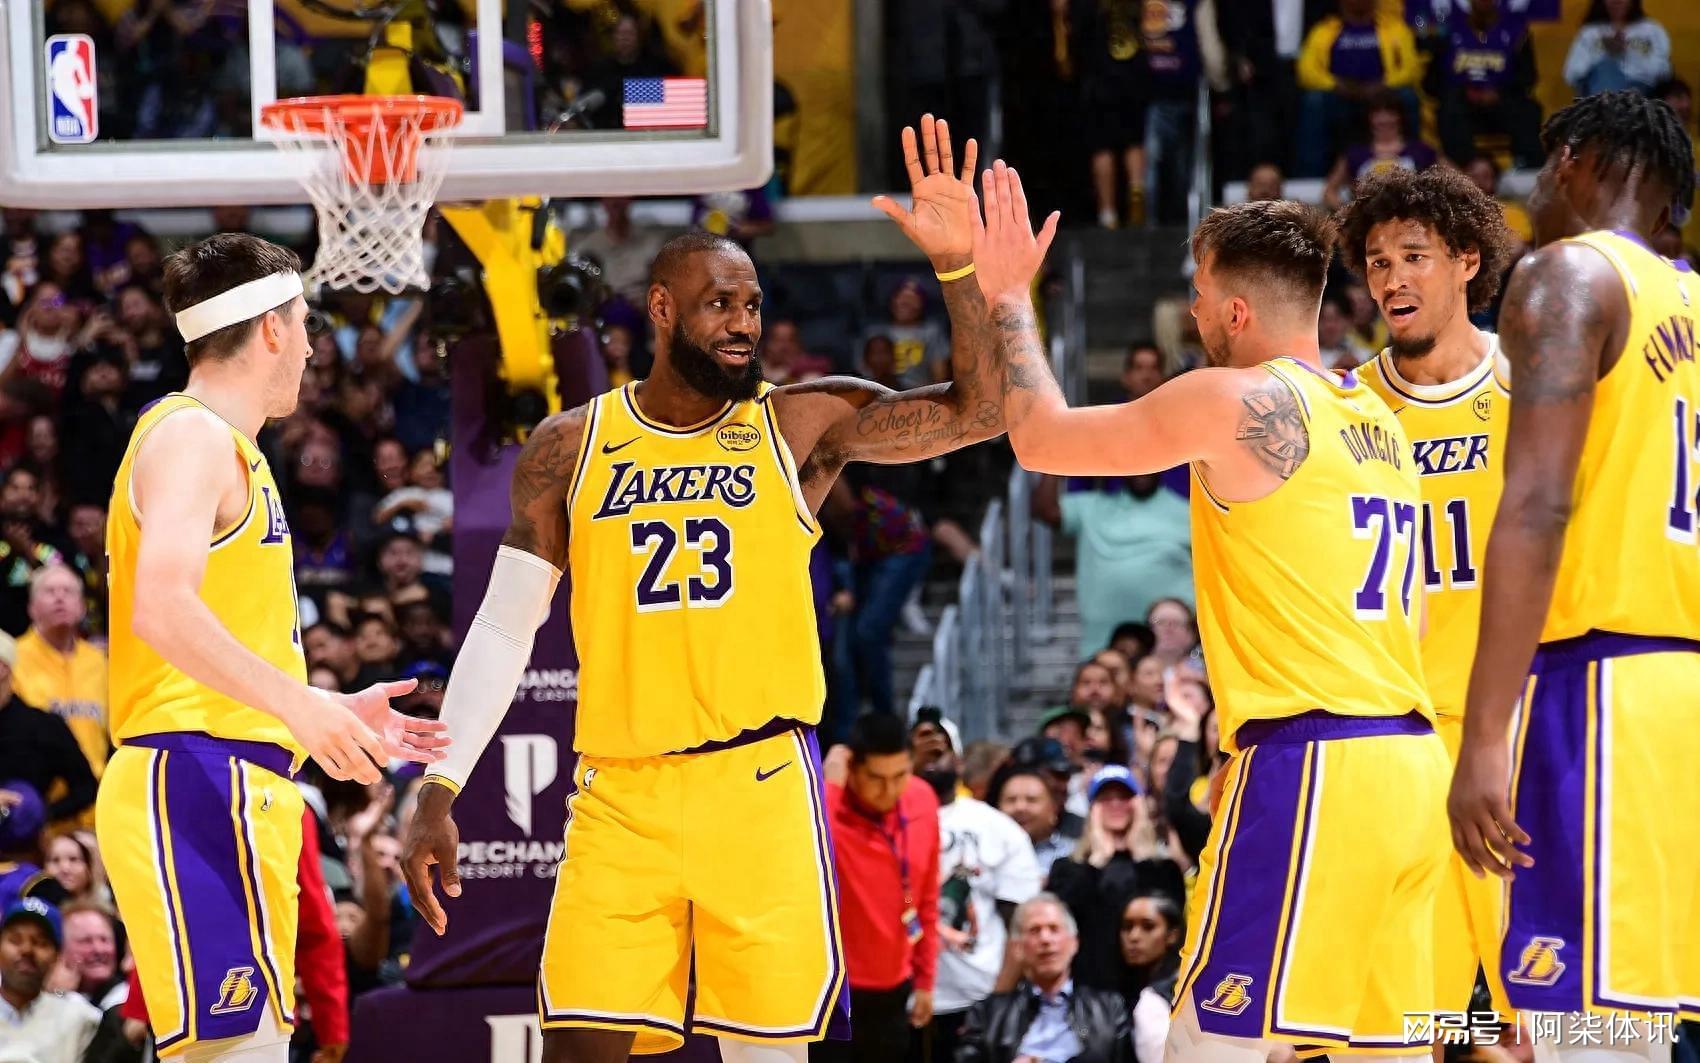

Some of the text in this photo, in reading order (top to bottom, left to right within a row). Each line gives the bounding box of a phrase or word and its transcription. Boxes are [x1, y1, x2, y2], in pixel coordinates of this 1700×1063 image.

[720, 430, 758, 443] bibigo
[1413, 434, 1489, 476] KER
[593, 461, 756, 519] LAKERS
[630, 518, 733, 610] 23
[1350, 495, 1417, 618] 77
[457, 840, 565, 863] PECHAN
